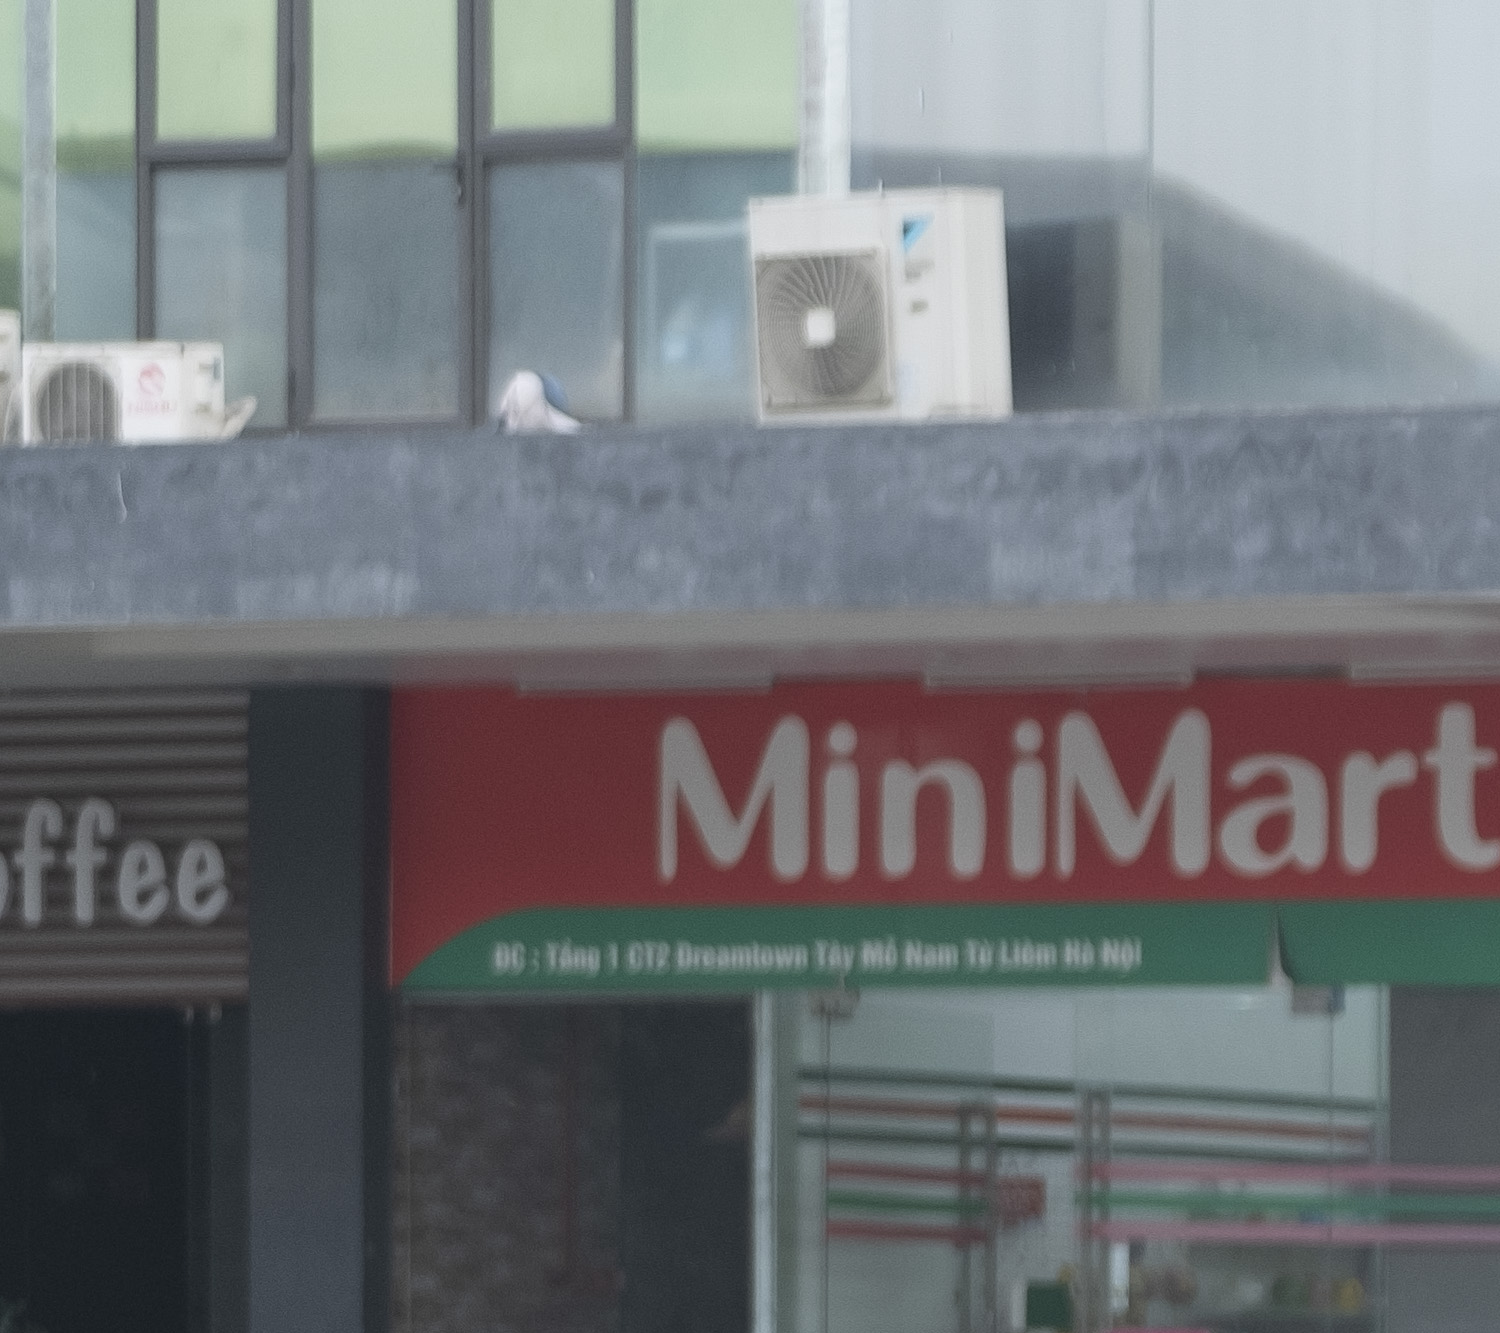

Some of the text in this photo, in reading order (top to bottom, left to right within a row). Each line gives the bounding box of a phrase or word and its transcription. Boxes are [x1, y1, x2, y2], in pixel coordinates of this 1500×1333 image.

[0, 798, 229, 924] ffee
[626, 940, 672, 973] CT2
[676, 940, 809, 973] Dreamtown
[905, 939, 959, 971] Nam
